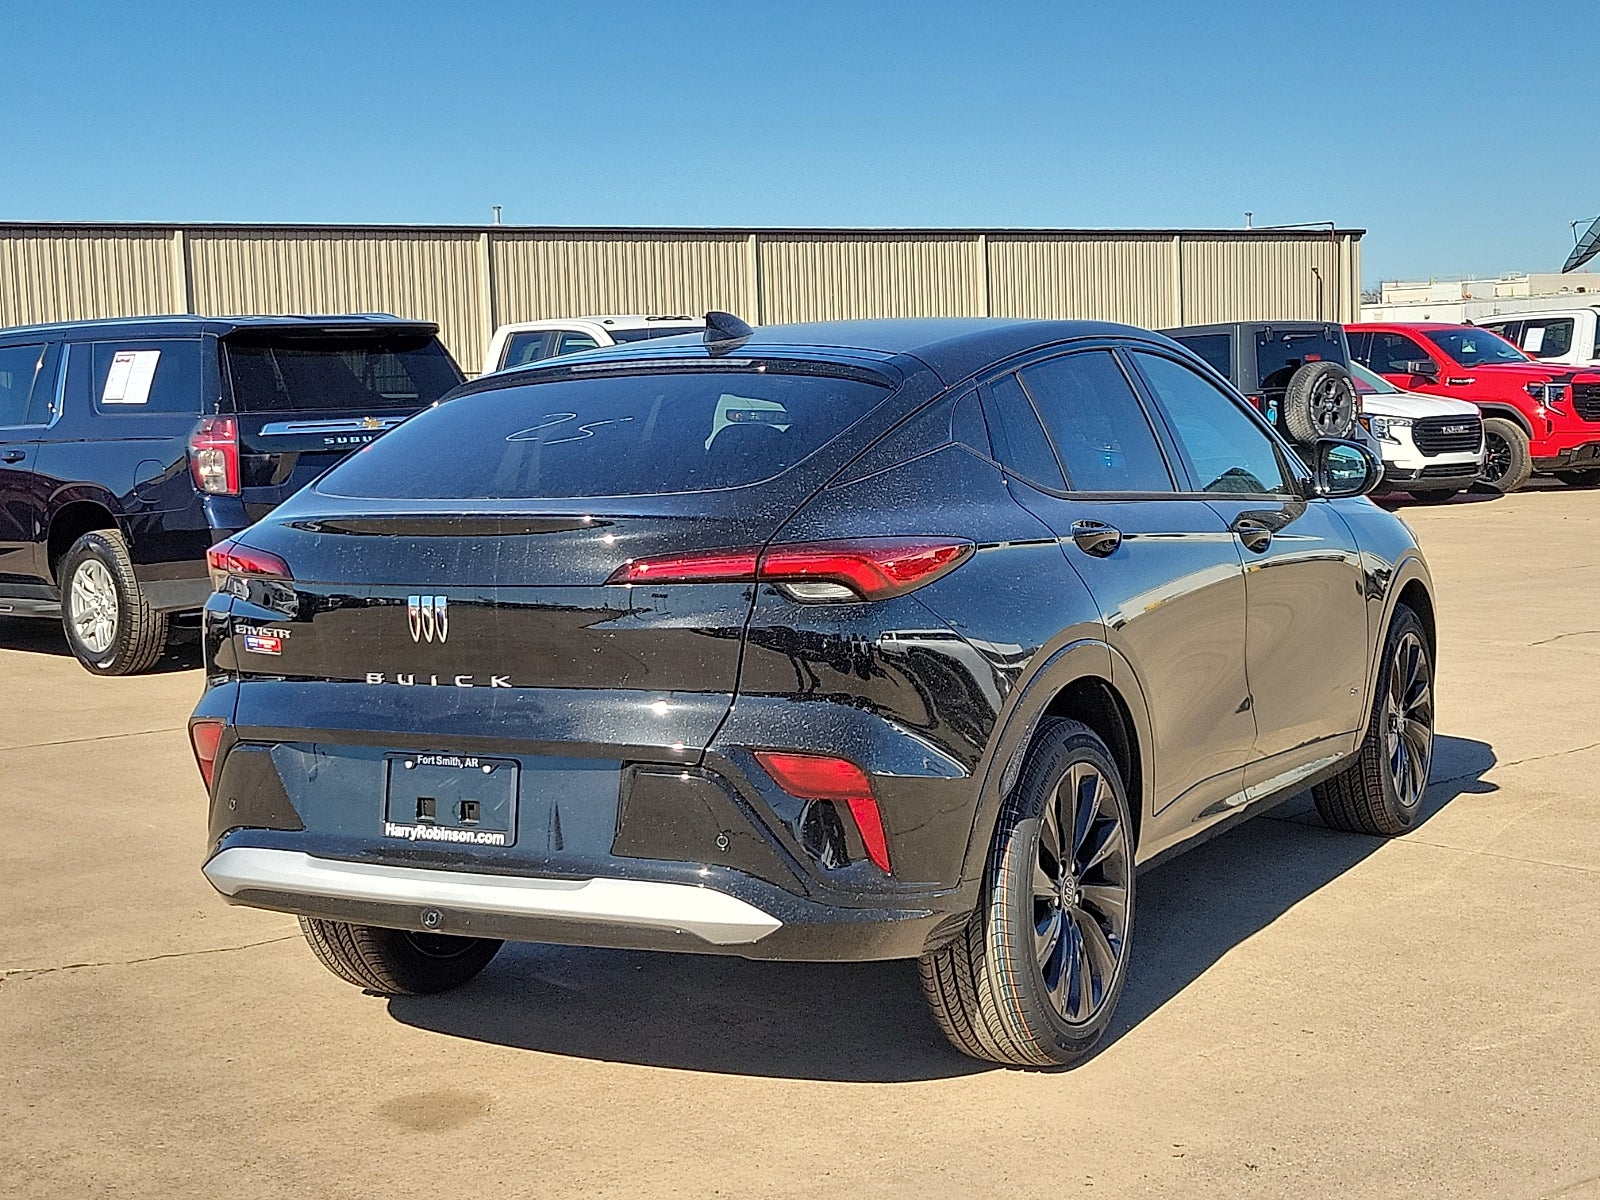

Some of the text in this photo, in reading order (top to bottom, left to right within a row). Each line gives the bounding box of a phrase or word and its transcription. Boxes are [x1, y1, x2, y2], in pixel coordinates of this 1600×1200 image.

[366, 672, 513, 688] BUICK
[417, 755, 479, 769] Fort Smith, AR
[385, 822, 505, 846] HarryRobinson.com
